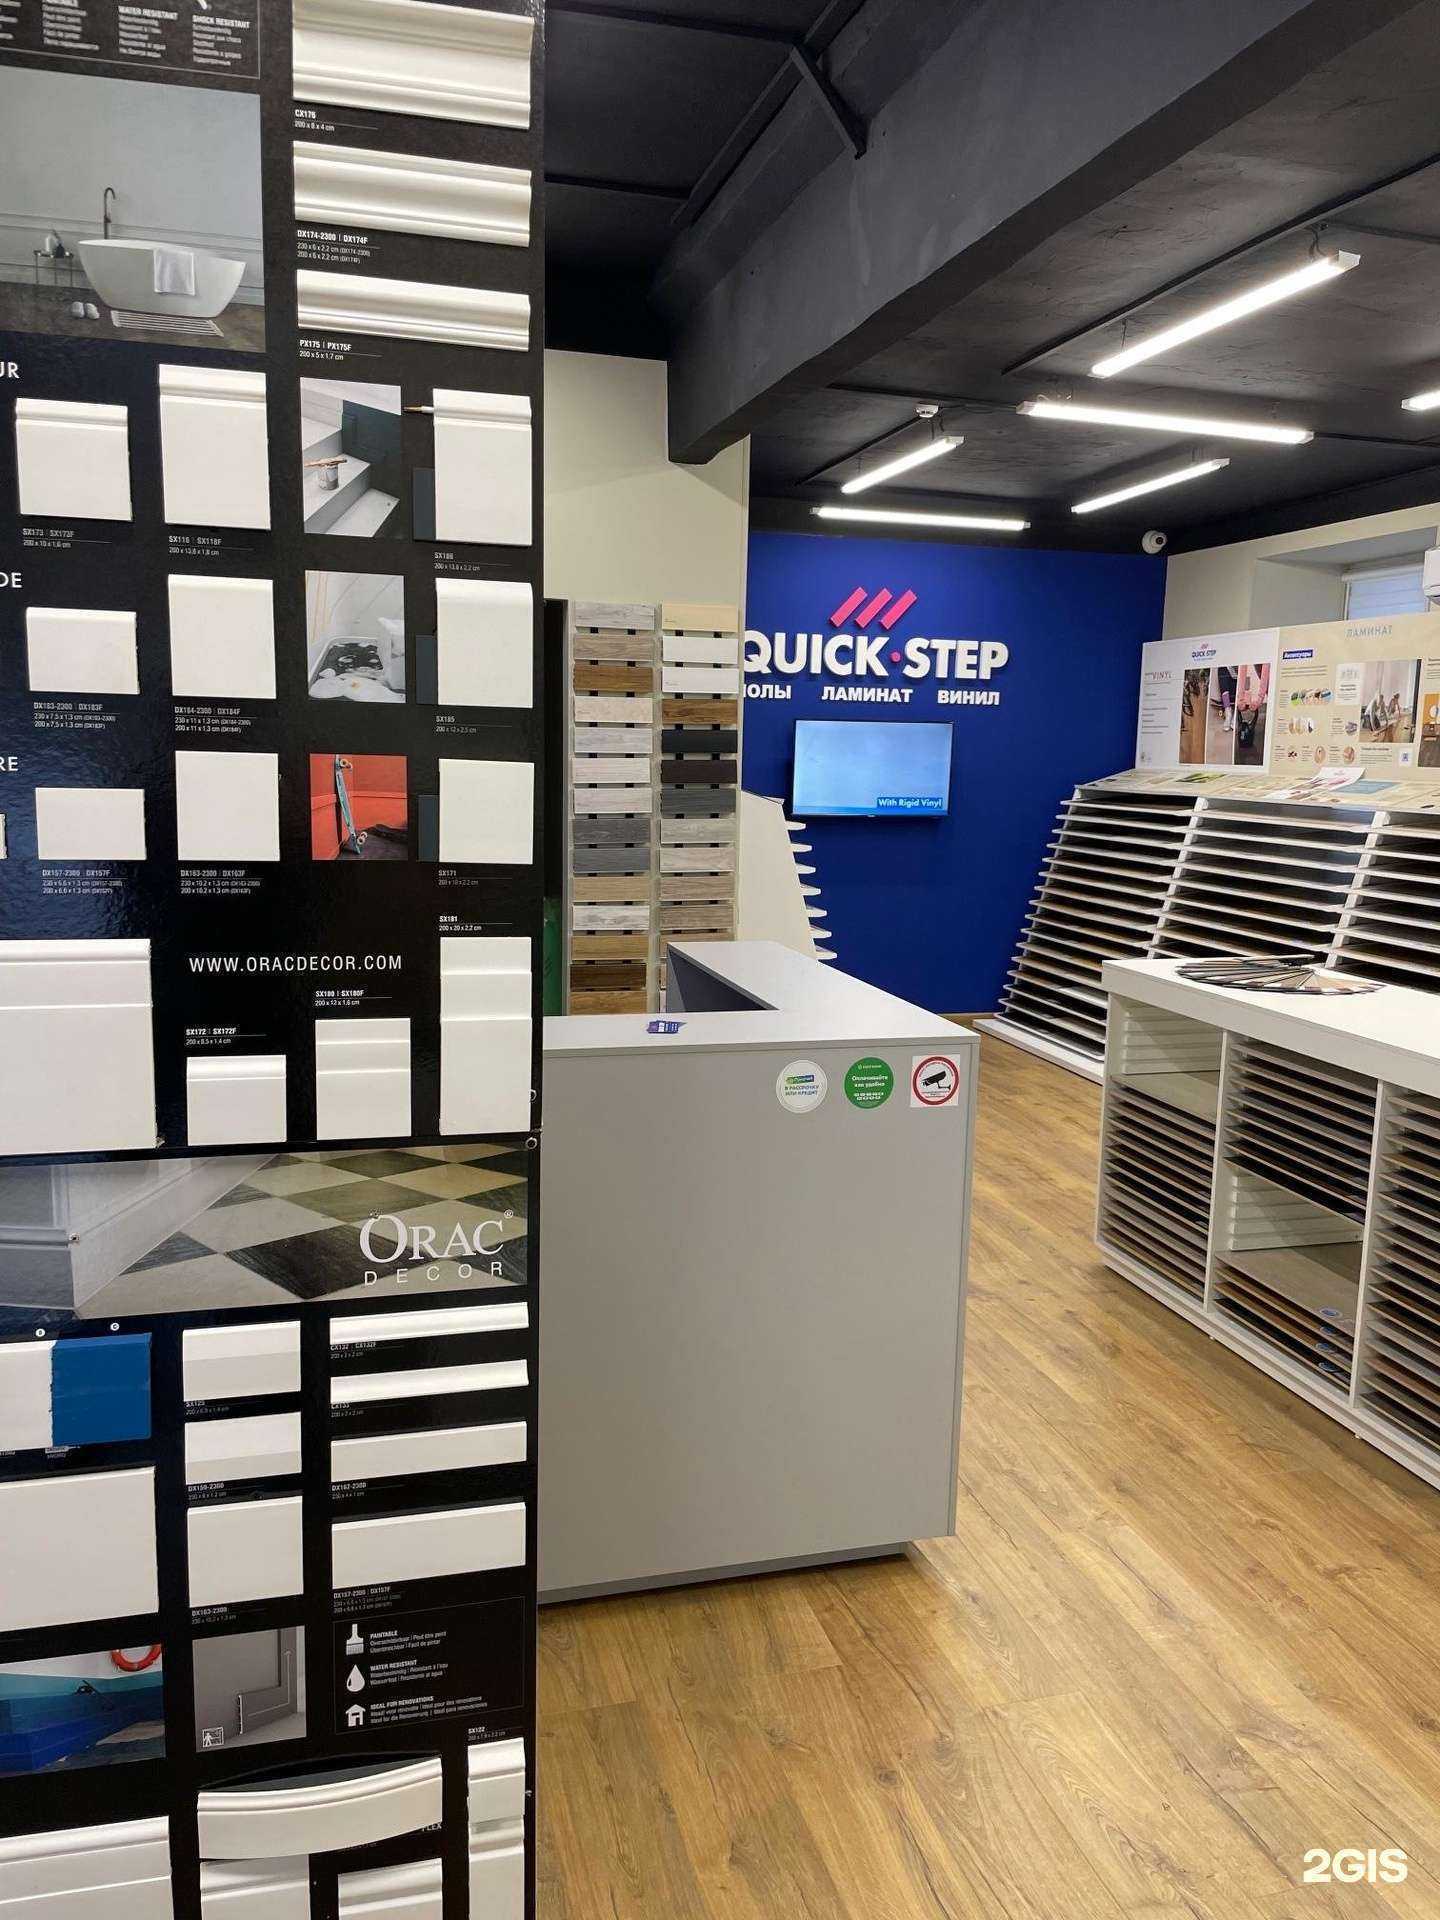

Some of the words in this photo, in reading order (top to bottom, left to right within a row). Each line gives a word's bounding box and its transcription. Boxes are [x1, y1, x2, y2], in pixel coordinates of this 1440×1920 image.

[343, 234, 368, 244] DX174F
[300, 339, 320, 349] PX175
[327, 342, 352, 351] PX175F
[300, 350, 310, 358] 200
[326, 352, 334, 360] 1.7
[1346, 625, 1392, 638] ЛАМИНАТ
[821, 686, 913, 703] ЛАМИНАТ
[937, 690, 1000, 706] ВИНИЛ
[878, 798, 897, 807] With
[899, 798, 919, 809] Rigid
[921, 798, 942, 809] Vinyl
[189, 955, 402, 973] WWW.ORACDECOR.COM
[360, 1214, 504, 1264] ORAC
[364, 1261, 503, 1286] DECOR
[370, 1663, 388, 1671] WATER
[389, 1660, 417, 1668] RESISTANT
